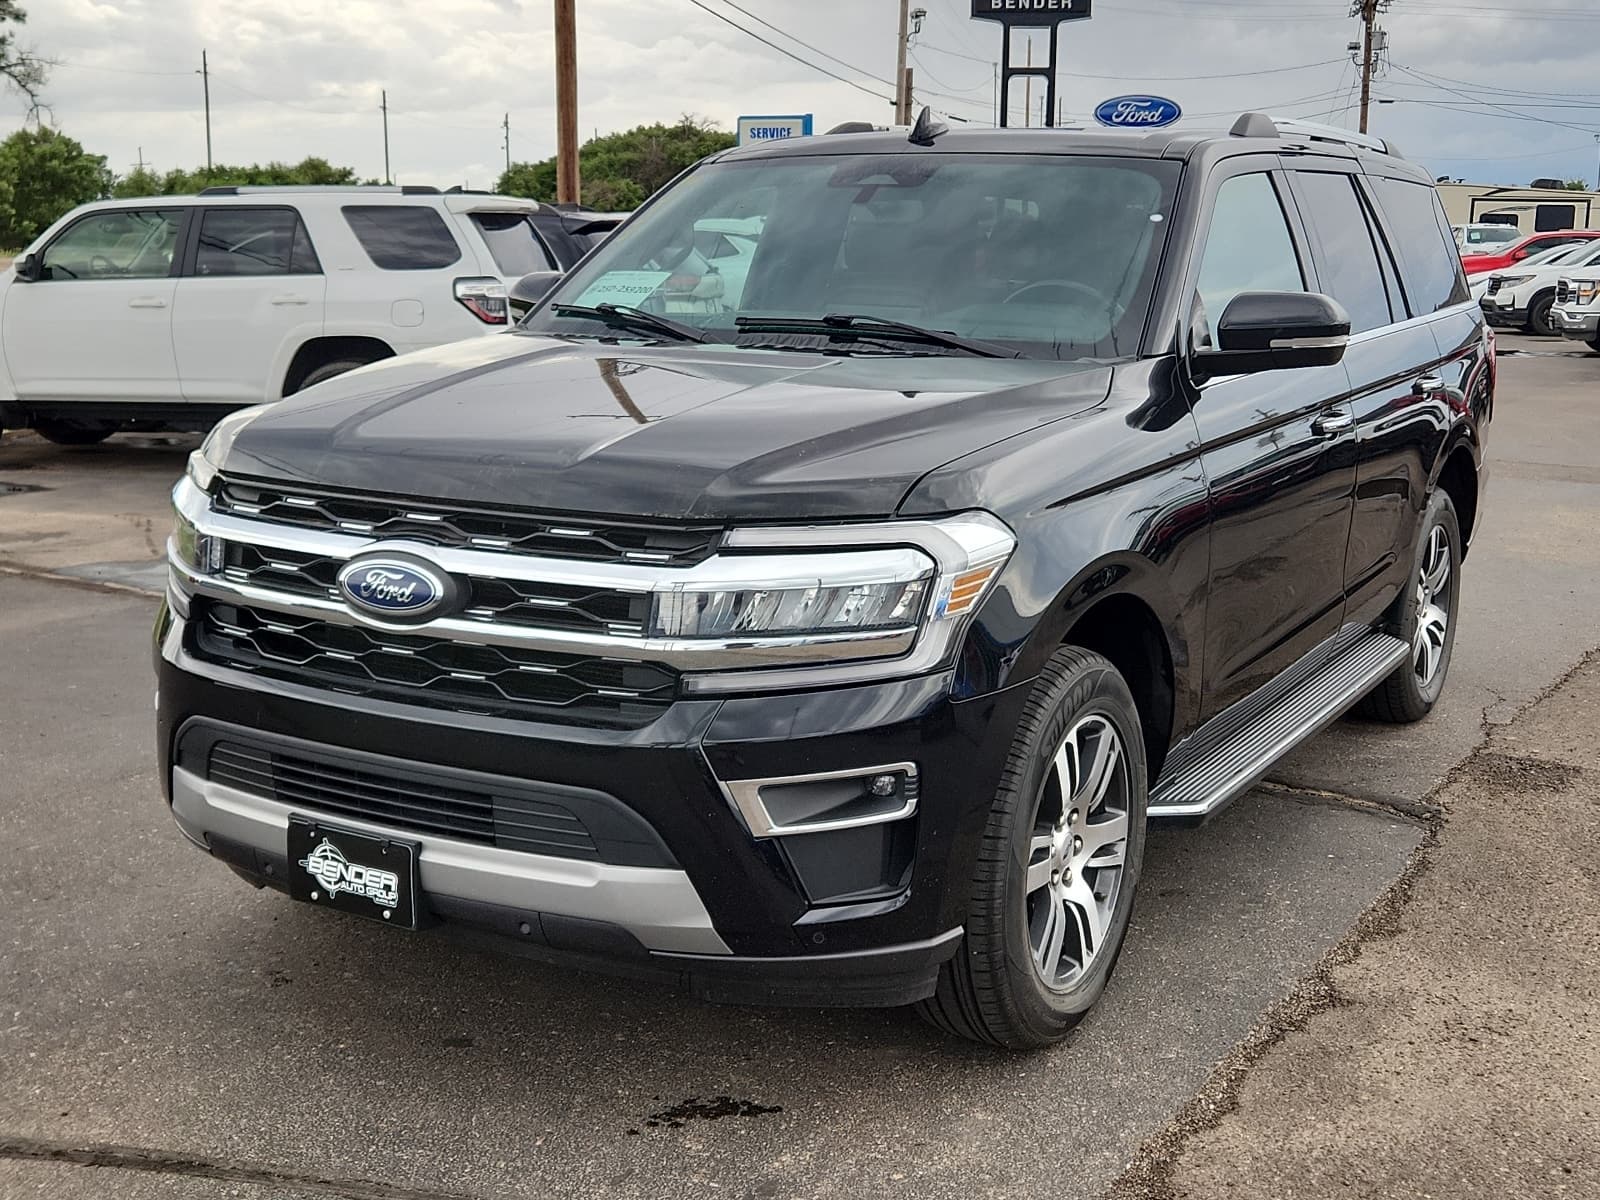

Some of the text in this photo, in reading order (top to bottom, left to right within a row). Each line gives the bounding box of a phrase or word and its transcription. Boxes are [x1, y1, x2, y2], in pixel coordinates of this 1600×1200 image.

[991, 0, 1072, 9] BENDER
[1112, 101, 1164, 122] Ford
[750, 127, 792, 139] SERVICE
[360, 569, 416, 603] Ford
[308, 855, 397, 892] BENDER
[341, 880, 397, 900] AUTO GROUP
